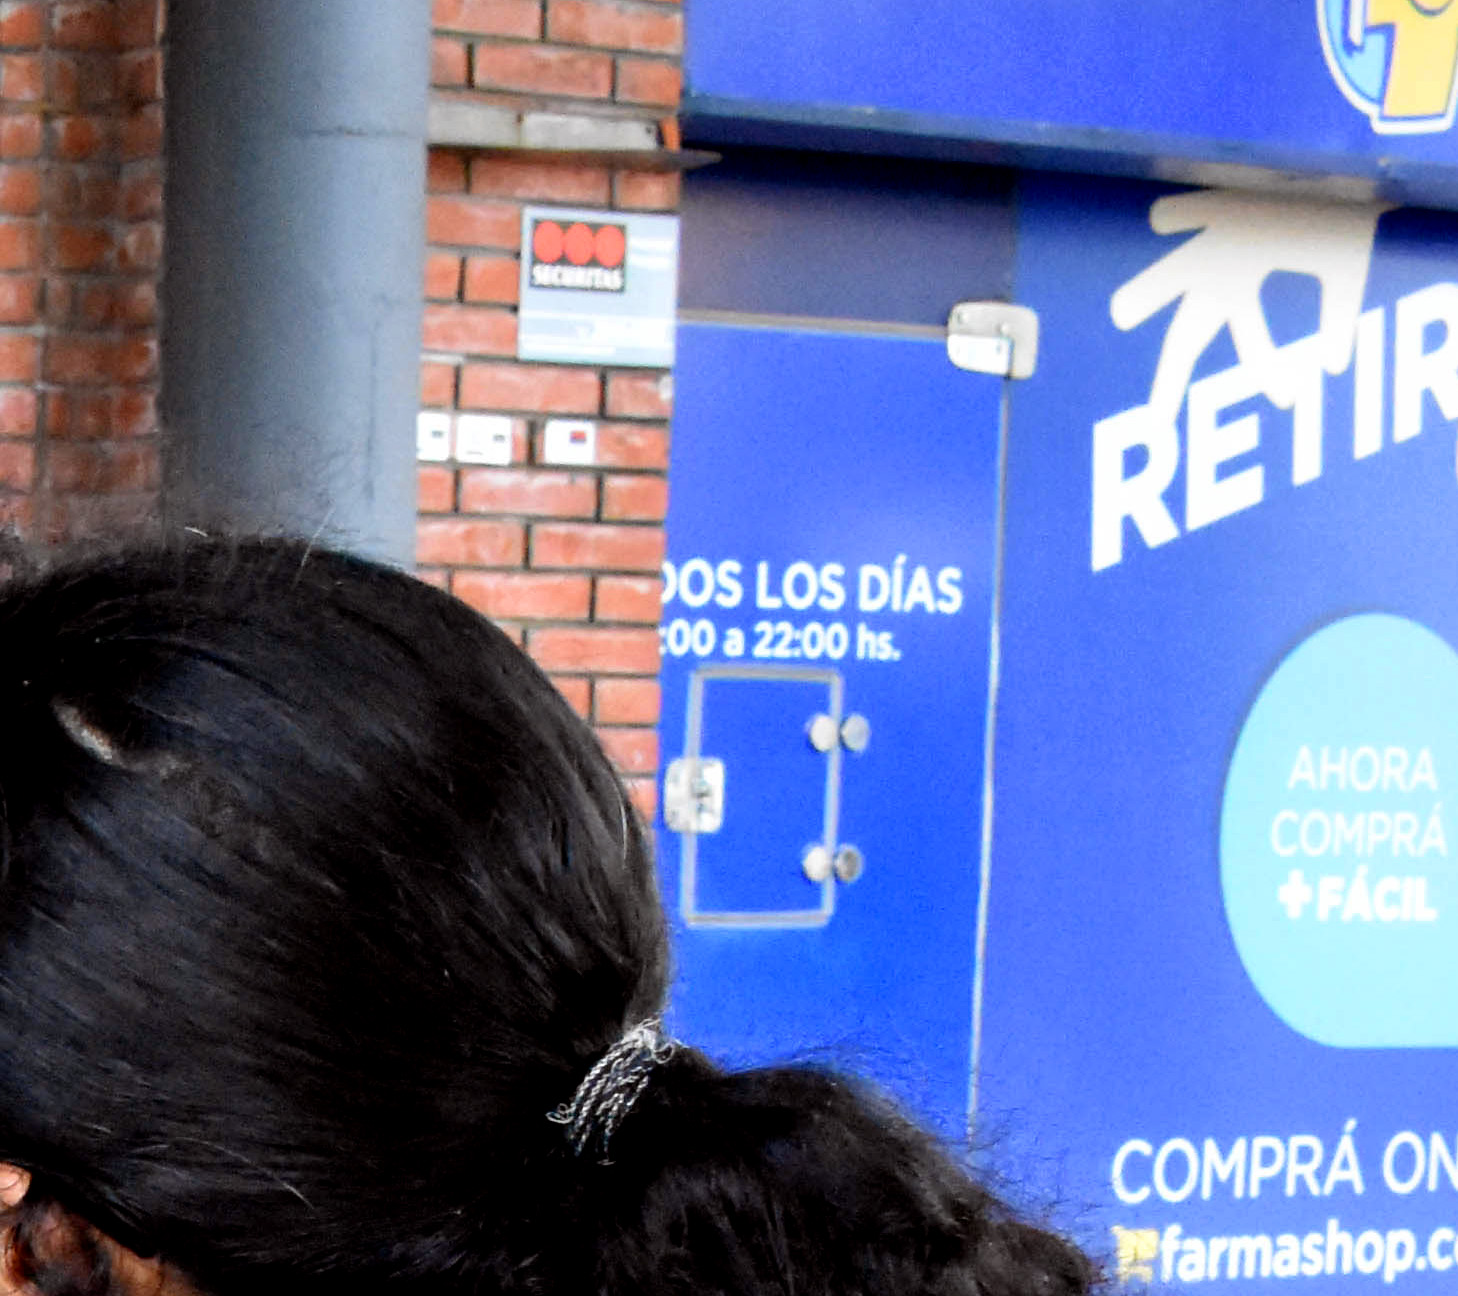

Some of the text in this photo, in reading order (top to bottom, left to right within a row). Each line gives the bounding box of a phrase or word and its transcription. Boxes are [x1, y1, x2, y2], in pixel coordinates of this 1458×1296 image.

[756, 560, 846, 611] LOS
[858, 553, 964, 615] DÍAS
[723, 627, 745, 657] a
[752, 620, 849, 660] 22:00
[856, 622, 902, 662] hs.
[1287, 744, 1439, 792] AHORA
[1270, 802, 1449, 859] COMPRÁ
[1111, 1118, 1366, 1204] COMPRÁ
